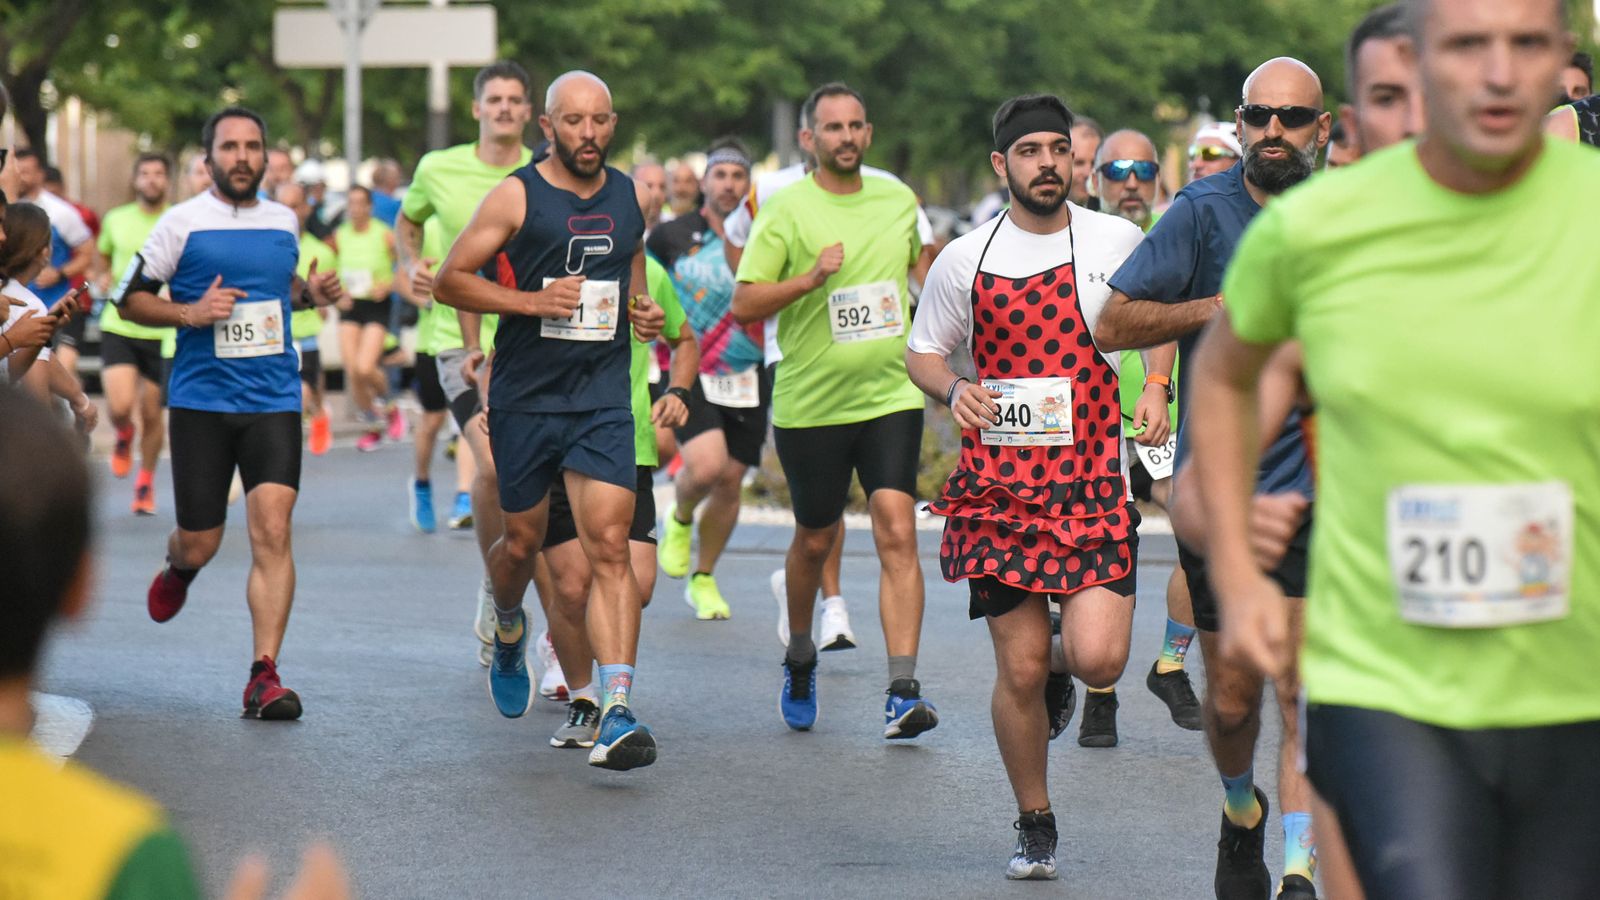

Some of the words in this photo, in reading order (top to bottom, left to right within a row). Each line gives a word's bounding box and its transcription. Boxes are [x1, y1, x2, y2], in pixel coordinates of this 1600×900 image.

[837, 305, 872, 328] 592
[222, 323, 254, 342] 195
[1406, 536, 1487, 584] 210
